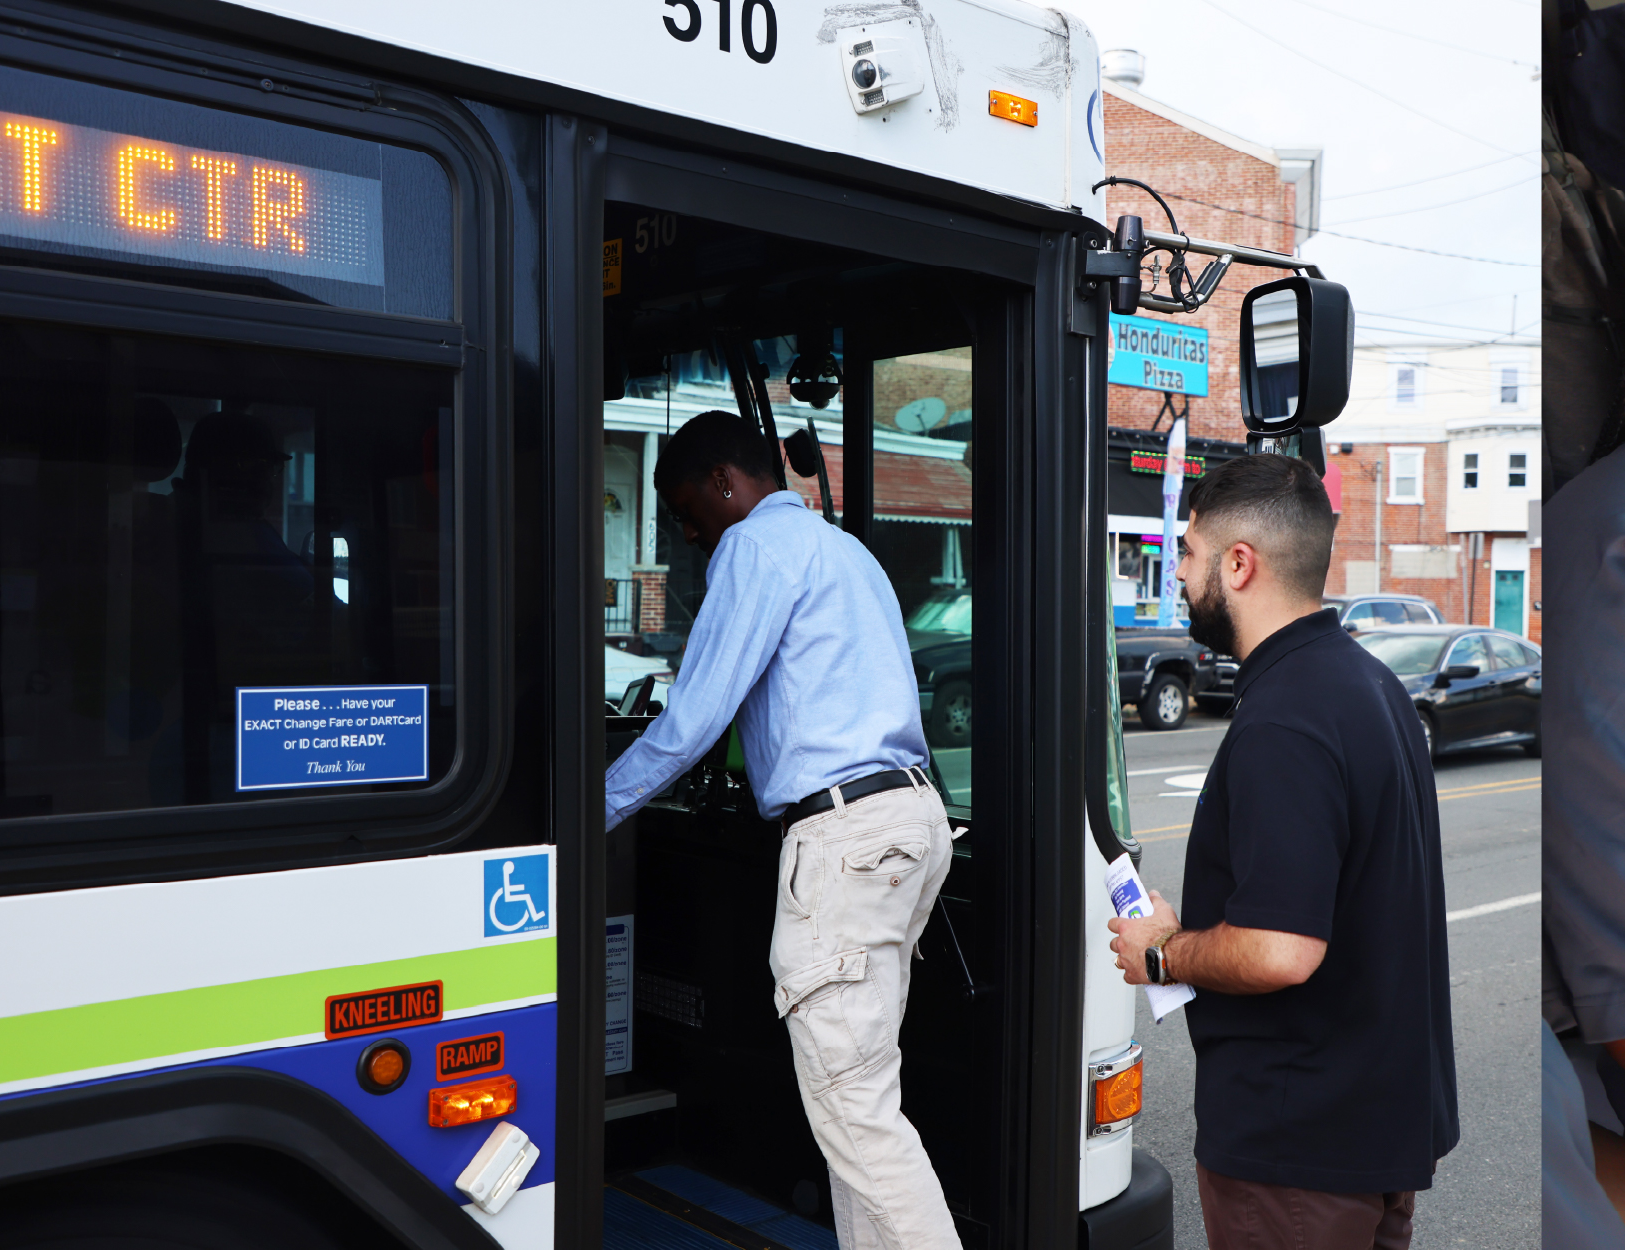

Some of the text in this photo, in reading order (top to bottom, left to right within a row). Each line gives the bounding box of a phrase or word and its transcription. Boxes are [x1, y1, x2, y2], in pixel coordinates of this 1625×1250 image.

[663, 0, 777, 64] 510
[118, 144, 305, 253] CTR
[635, 213, 677, 254] 510
[1118, 322, 1206, 364] Honduritas
[1143, 359, 1185, 391] Pizza
[274, 698, 320, 711] Please
[341, 698, 368, 709] Have
[371, 698, 395, 710] your
[244, 715, 422, 731] EXACT Change Fare or DARTCard
[284, 733, 386, 750] or ID Card READY.
[307, 759, 366, 775] Thank You
[334, 988, 436, 1030] KNEELING
[442, 1040, 499, 1070] RAMP
